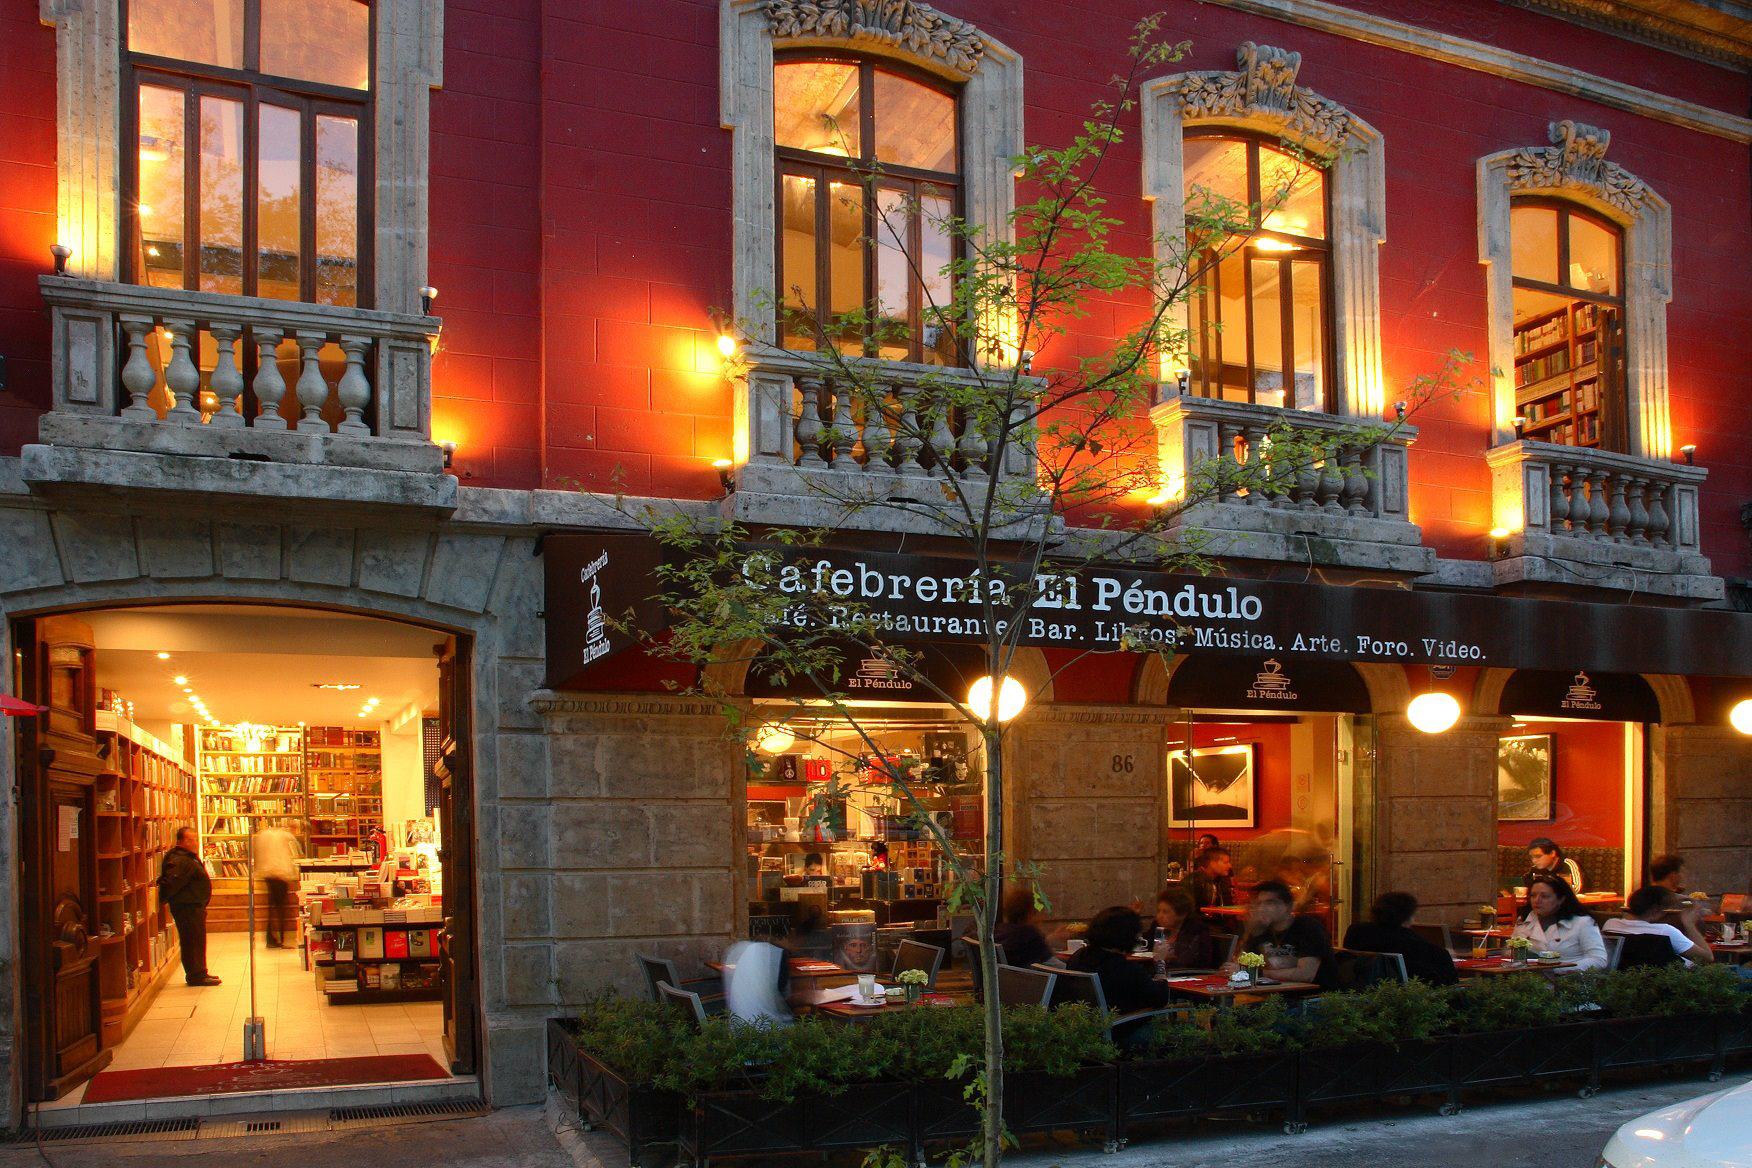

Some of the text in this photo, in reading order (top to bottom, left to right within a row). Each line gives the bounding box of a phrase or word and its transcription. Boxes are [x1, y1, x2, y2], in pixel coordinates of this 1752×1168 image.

[1033, 574, 1082, 610] El
[1092, 577, 1263, 621] Péndulo
[1028, 618, 1084, 641] Bar.
[1194, 627, 1284, 651] Música.
[1290, 632, 1349, 654] Arte.
[1357, 635, 1414, 657] Foro.
[1422, 638, 1487, 660] Video.
[848, 678, 912, 690] El Péndulo
[1246, 689, 1298, 700] El Péndulo
[1560, 700, 1602, 710] El Péndulo
[1112, 754, 1134, 773] 86
